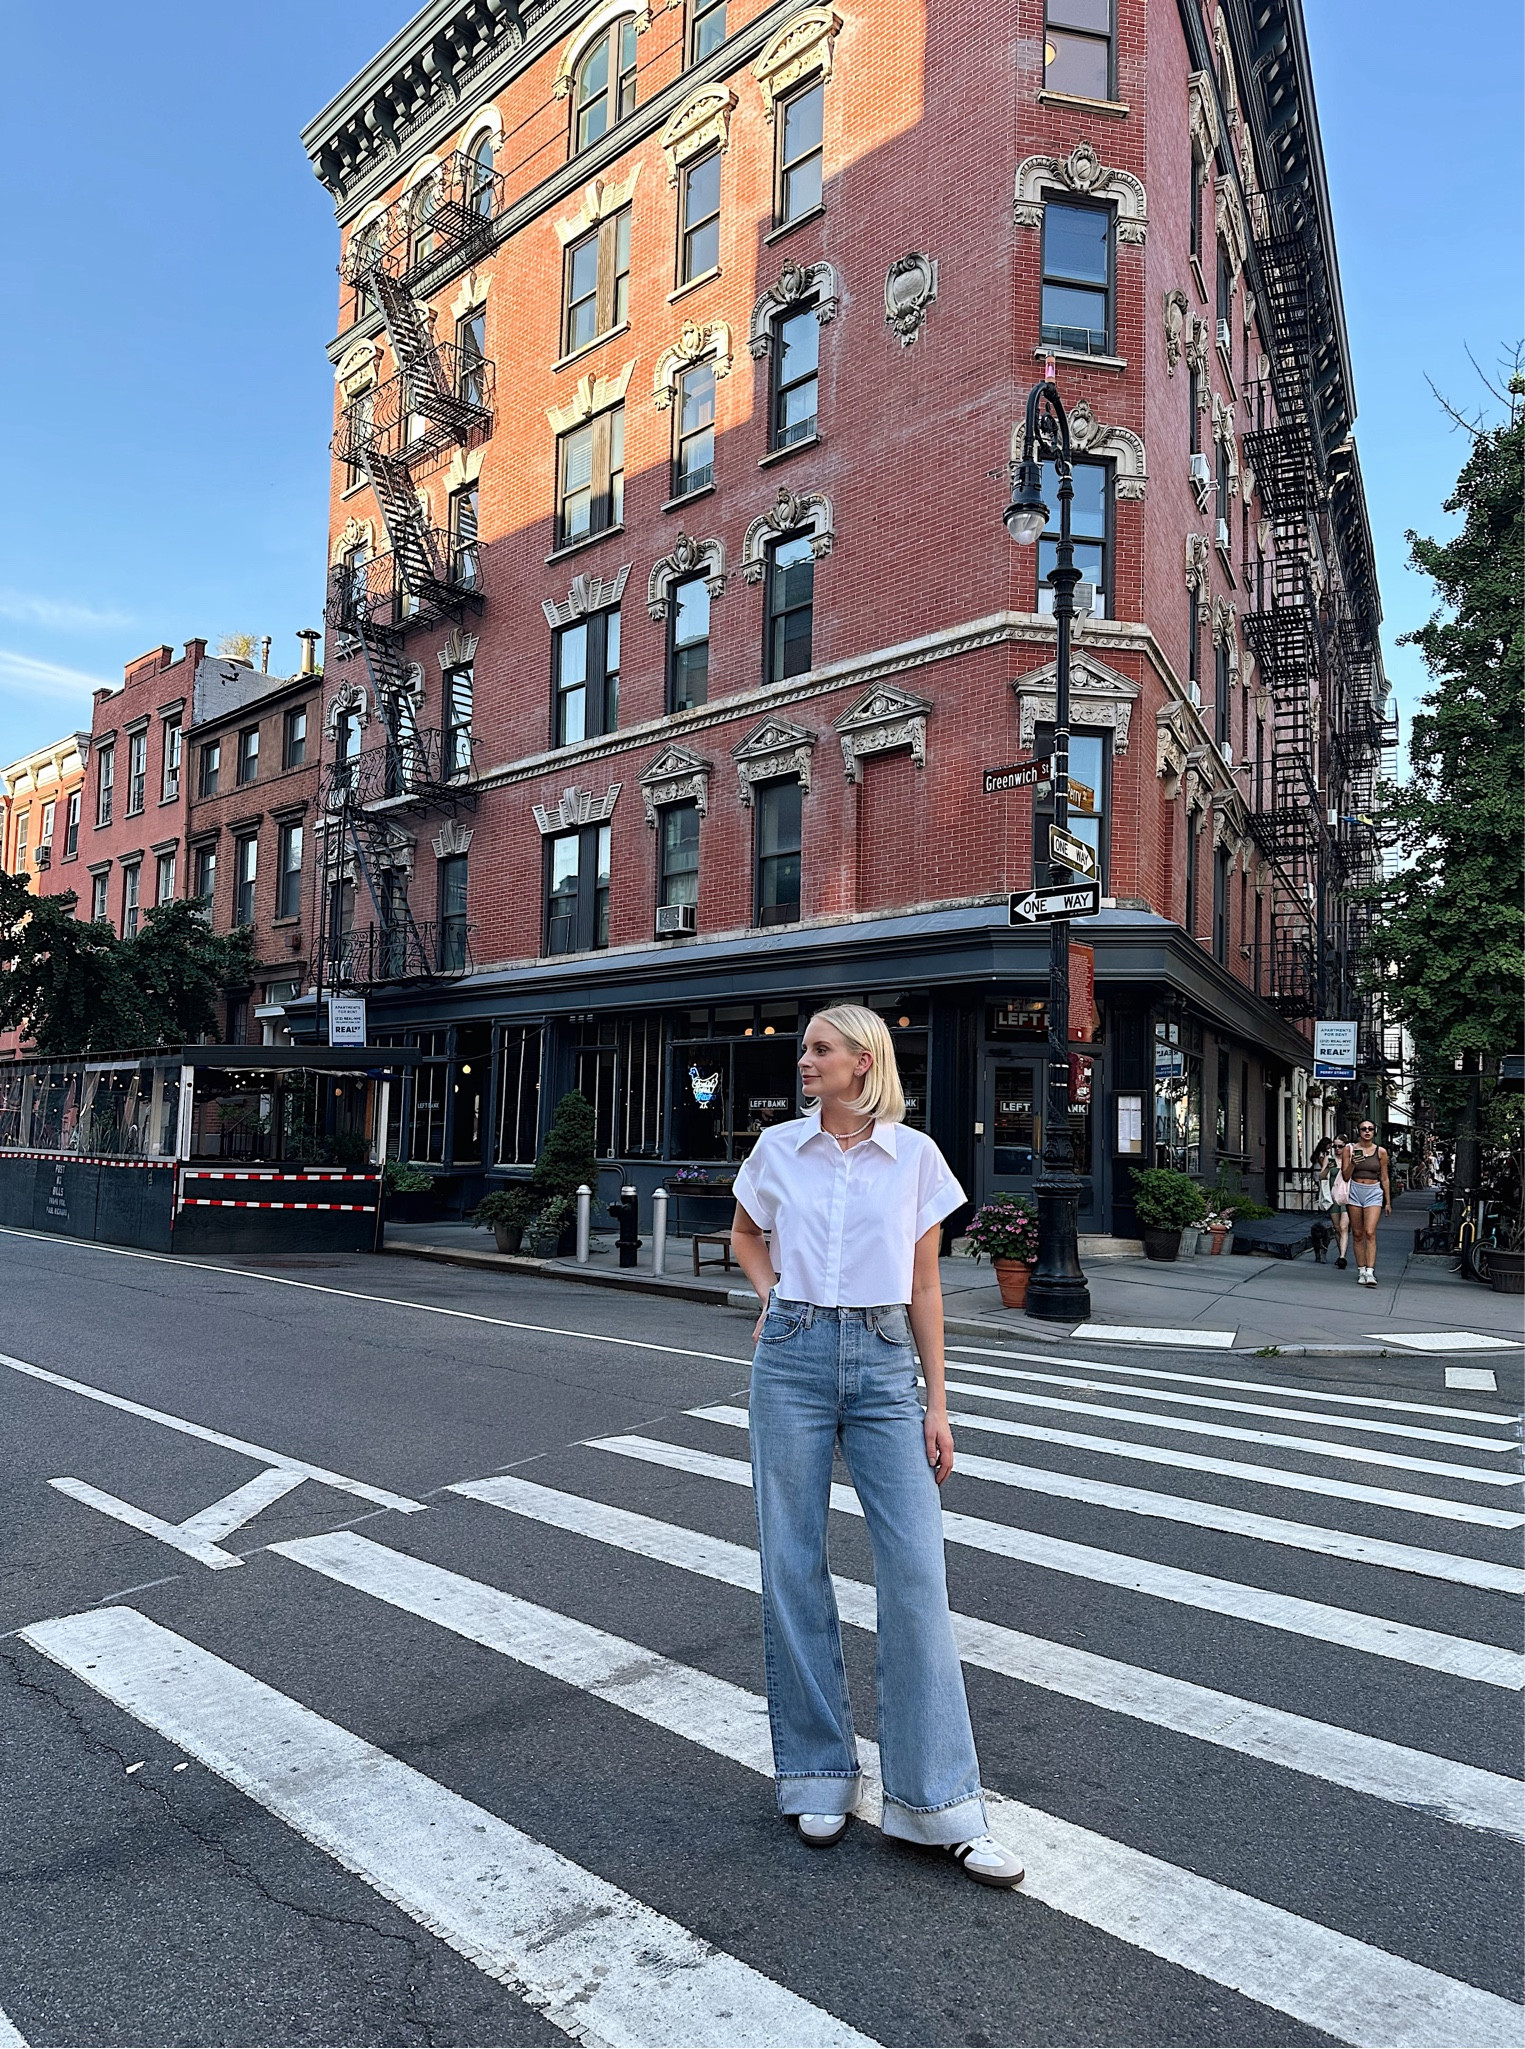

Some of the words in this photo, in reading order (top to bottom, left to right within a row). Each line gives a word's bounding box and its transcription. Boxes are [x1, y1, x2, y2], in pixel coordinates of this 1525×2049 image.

[986, 767, 1038, 791] Greenwich
[1041, 763, 1049, 774] St
[1056, 838, 1069, 856] ONE
[1076, 849, 1089, 866] WAY
[1023, 899, 1047, 914] ONE
[1064, 893, 1089, 909] WAY
[998, 1012, 1041, 1026] LEFT
[750, 1100, 767, 1108] LEFT
[767, 1100, 787, 1108] BANK
[905, 1098, 917, 1107] NK
[1002, 1103, 1031, 1111] LEFT
[1068, 1104, 1086, 1113] NK
[55, 1164, 65, 1174] POST
[52, 1186, 64, 1197] BILLS
